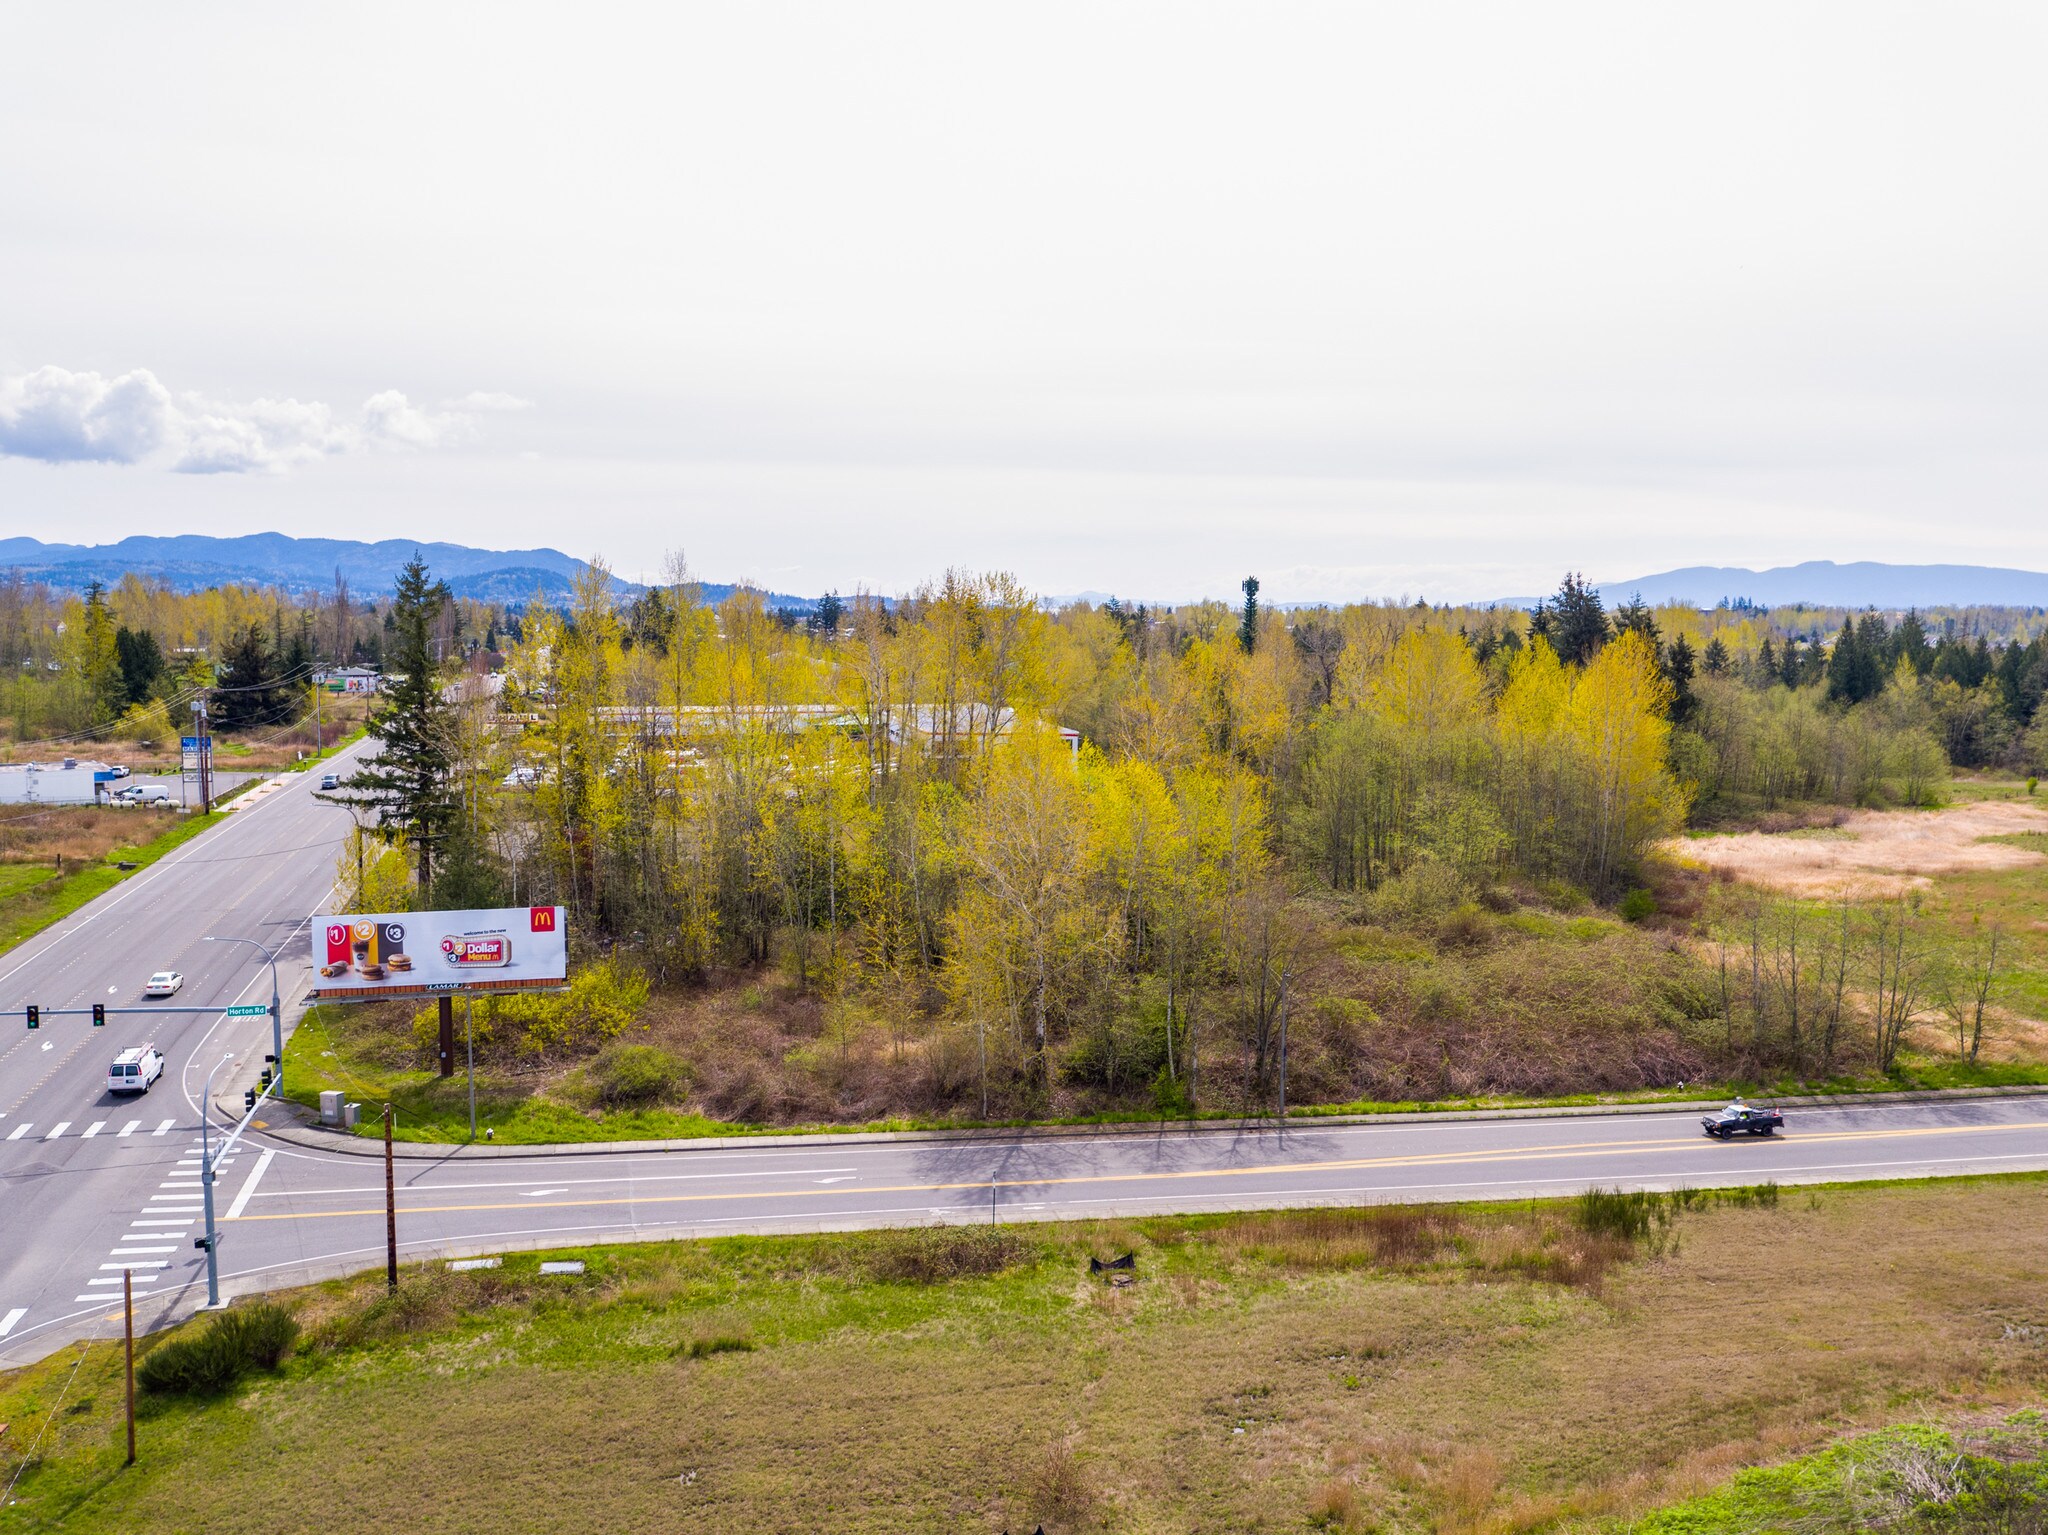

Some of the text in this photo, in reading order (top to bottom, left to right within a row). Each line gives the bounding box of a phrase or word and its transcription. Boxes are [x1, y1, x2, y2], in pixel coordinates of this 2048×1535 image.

[330, 929, 339, 940] $1
[357, 924, 370, 936] $2
[389, 928, 401, 939] $3
[467, 943, 499, 954] Dollar
